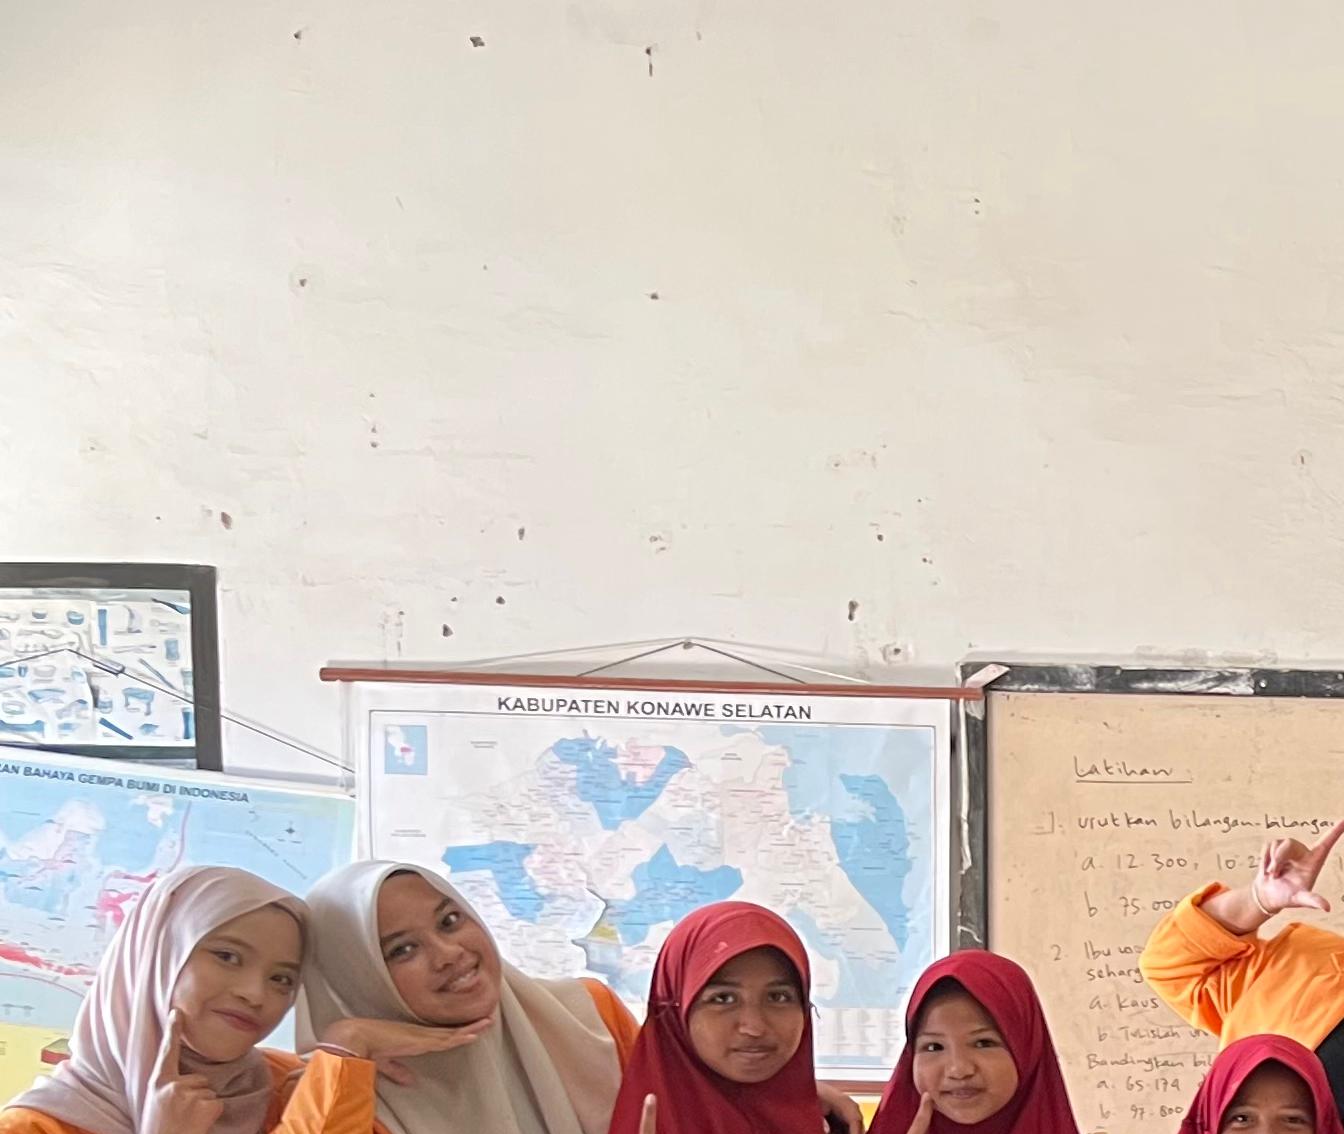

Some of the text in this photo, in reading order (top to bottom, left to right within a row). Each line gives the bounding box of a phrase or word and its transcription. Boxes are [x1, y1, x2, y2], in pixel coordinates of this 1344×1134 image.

[498, 696, 812, 720] KABUPATEN KONAWE SELATAN
[1073, 756, 1175, 777] Latihan
[23, 766, 75, 782] BAHAYA
[78, 773, 124, 788] GEMPA
[127, 779, 160, 794] BUMI
[162, 783, 177, 794] DI
[179, 786, 249, 803] INDONESIA
